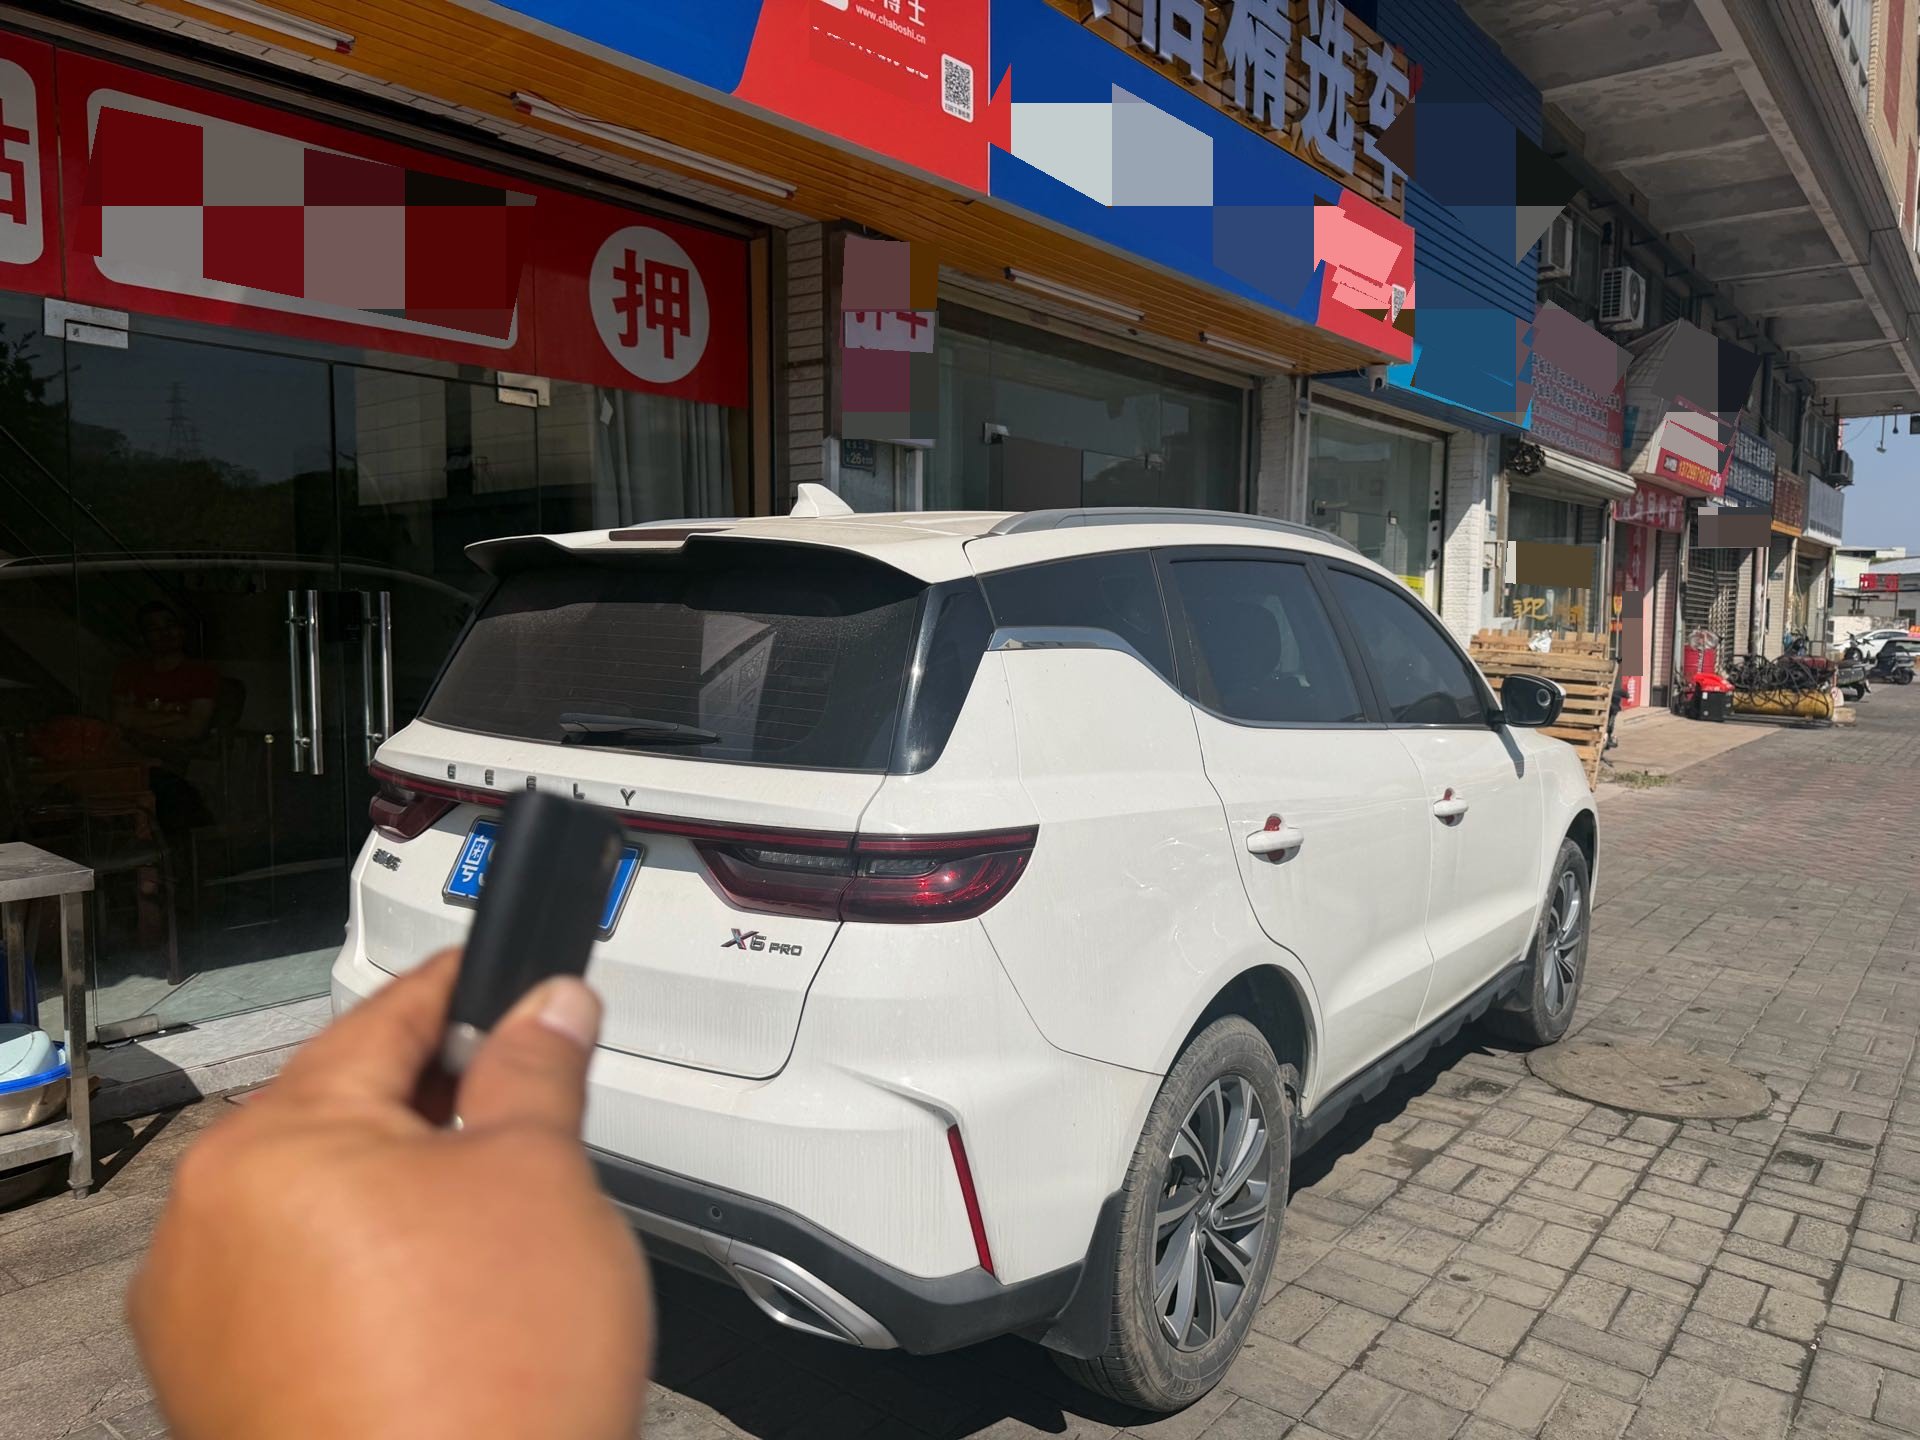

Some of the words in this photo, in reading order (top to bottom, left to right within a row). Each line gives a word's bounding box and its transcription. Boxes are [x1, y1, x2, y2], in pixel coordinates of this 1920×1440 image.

[855, 4, 926, 44] www.chaboshi.cn
[612, 248, 691, 360] 押
[447, 764, 636, 806] GEELY
[720, 927, 767, 952] X6
[769, 942, 803, 957] PRO
